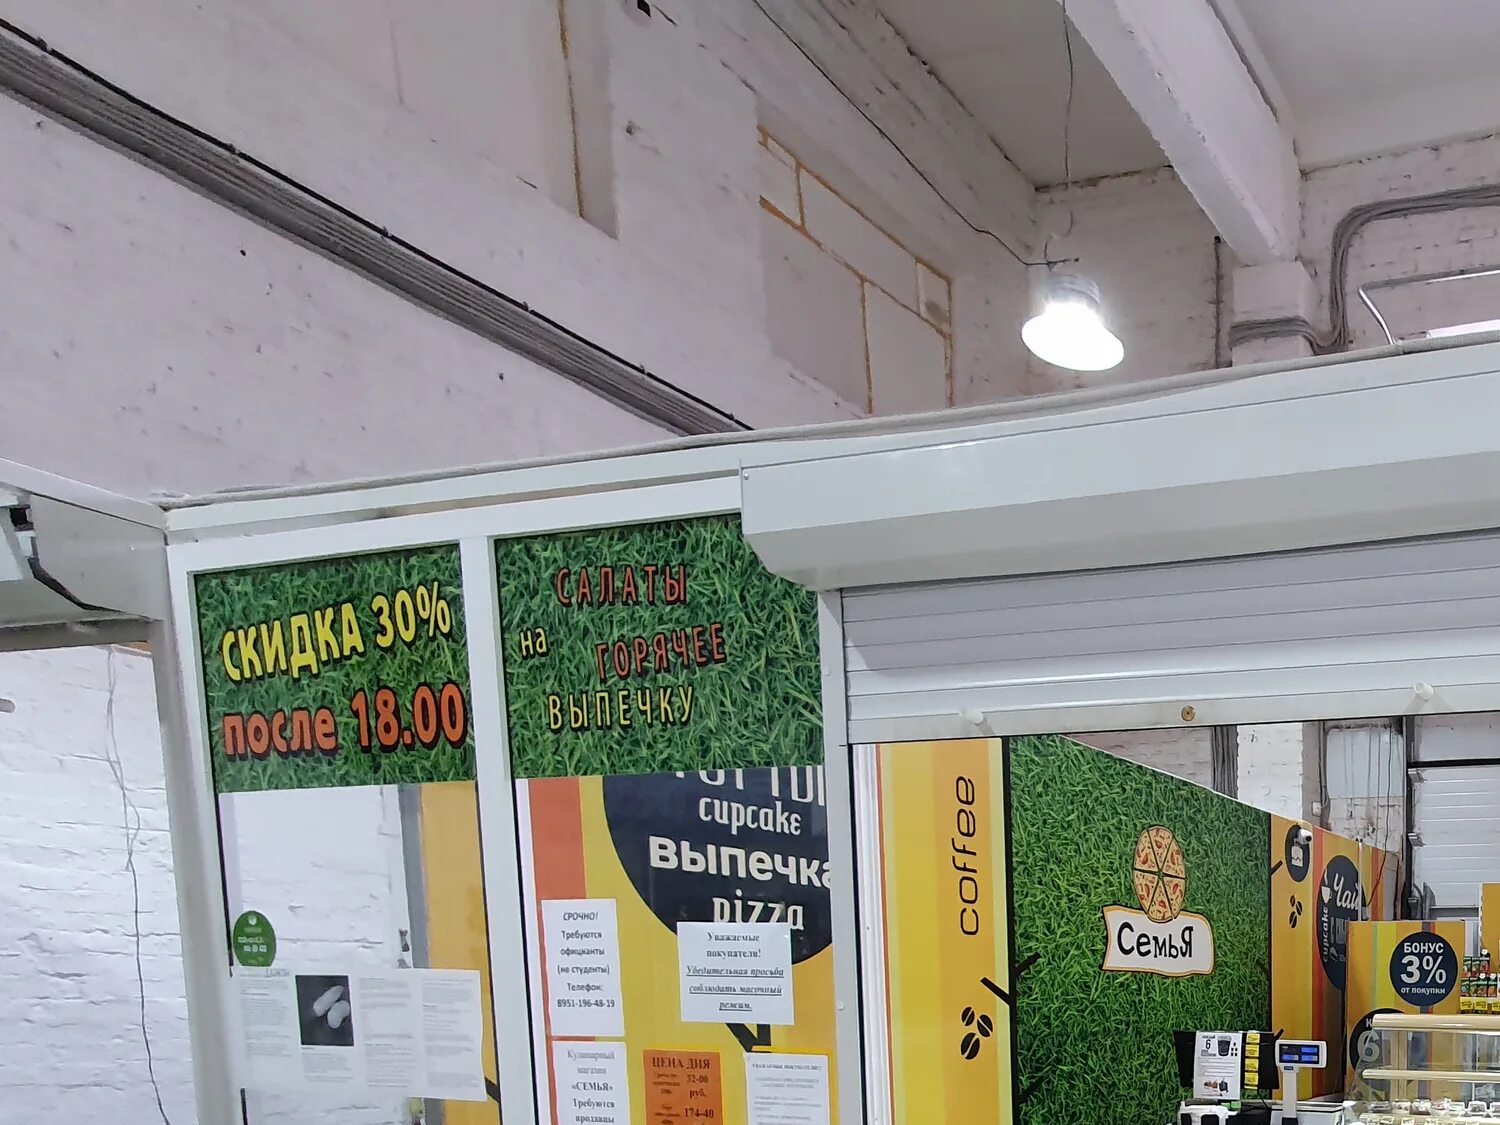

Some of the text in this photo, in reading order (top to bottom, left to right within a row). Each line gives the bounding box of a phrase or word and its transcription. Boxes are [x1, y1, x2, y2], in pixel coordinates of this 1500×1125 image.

[556, 565, 688, 607] САЛАТЫ
[220, 580, 453, 683] СКИДКА 30%
[519, 626, 547, 659] на
[597, 622, 729, 681] ГОРЯЧЕЕ
[222, 681, 468, 758] после 18.00
[547, 684, 695, 733] ВЫПЕЧКУ
[699, 798, 802, 835] cupcake
[952, 775, 979, 936] coffee
[563, 911, 599, 921] СРОЧНО!
[561, 930, 602, 941] Требуются
[707, 932, 760, 942] Уважаемые
[1403, 942, 1444, 954] БОНУС
[706, 949, 761, 960] покупатели!
[1400, 955, 1447, 985] 3%
[1411, 987, 1446, 996] покупки
